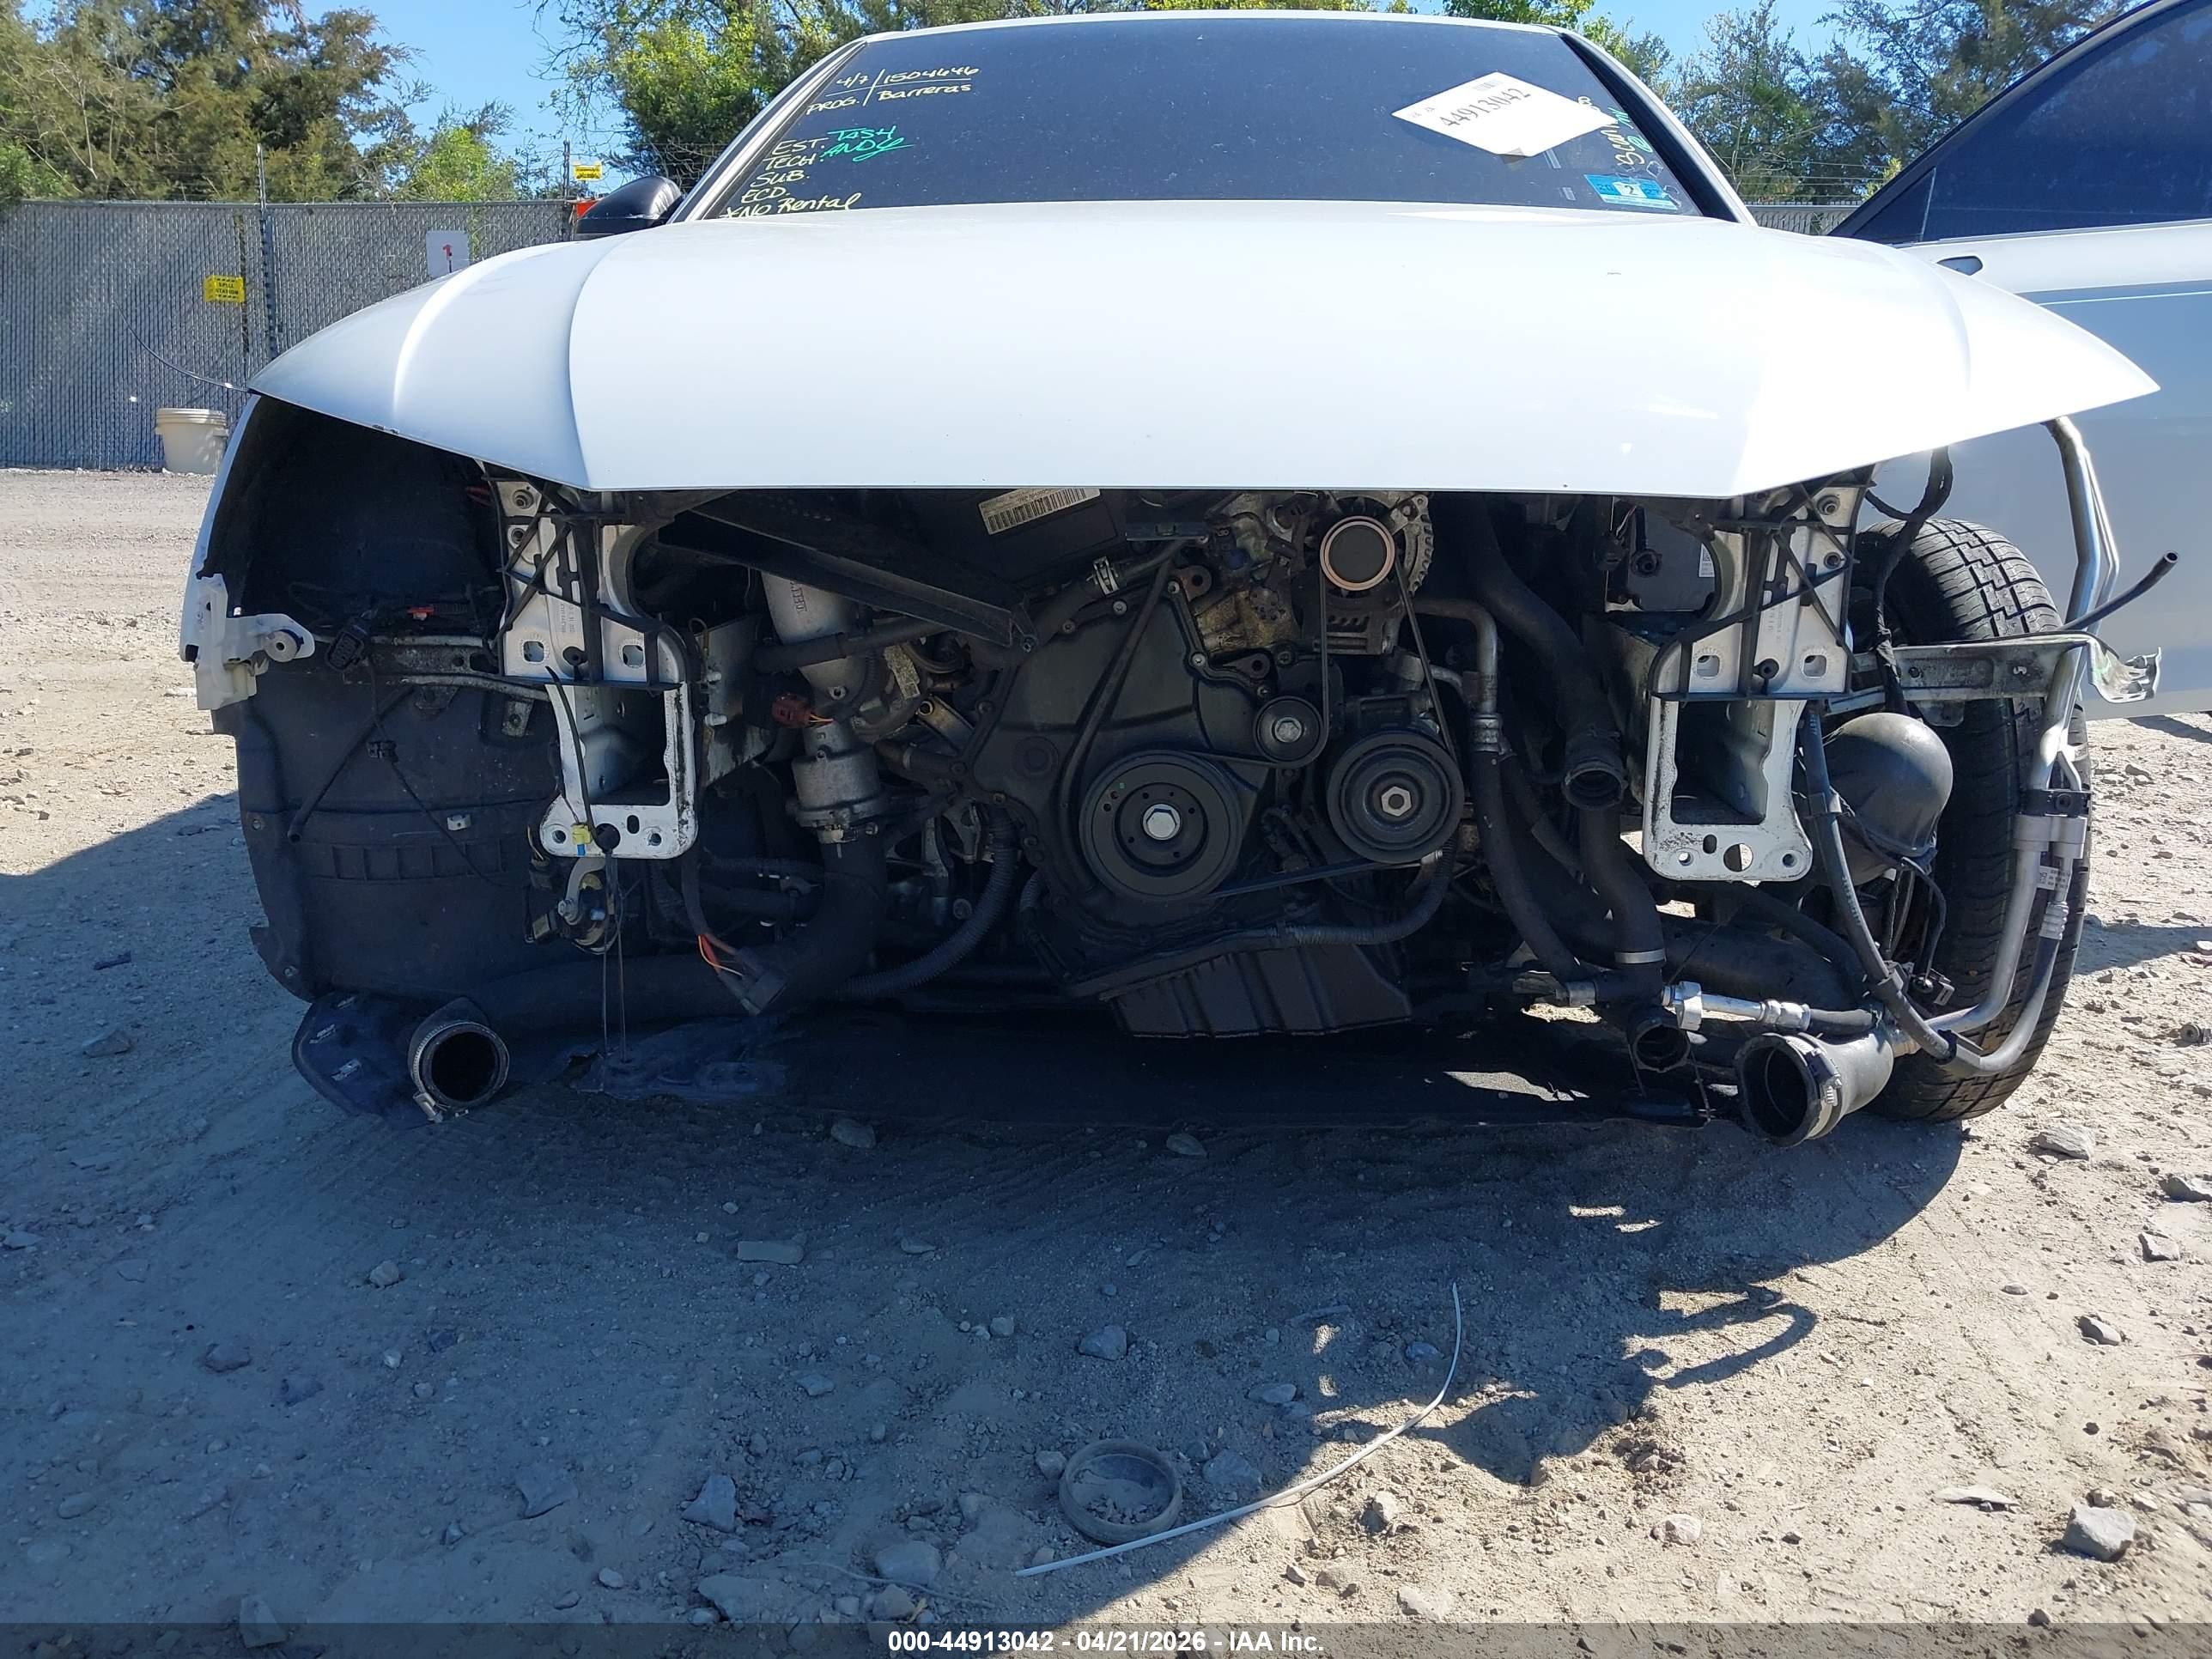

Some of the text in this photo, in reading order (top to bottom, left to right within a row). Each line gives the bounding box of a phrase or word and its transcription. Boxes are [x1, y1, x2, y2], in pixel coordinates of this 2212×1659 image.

[876, 84, 972, 101] Barreras
[1439, 88, 1531, 126] 44913042
[772, 137, 830, 155] EST.
[776, 192, 862, 214] Rental
